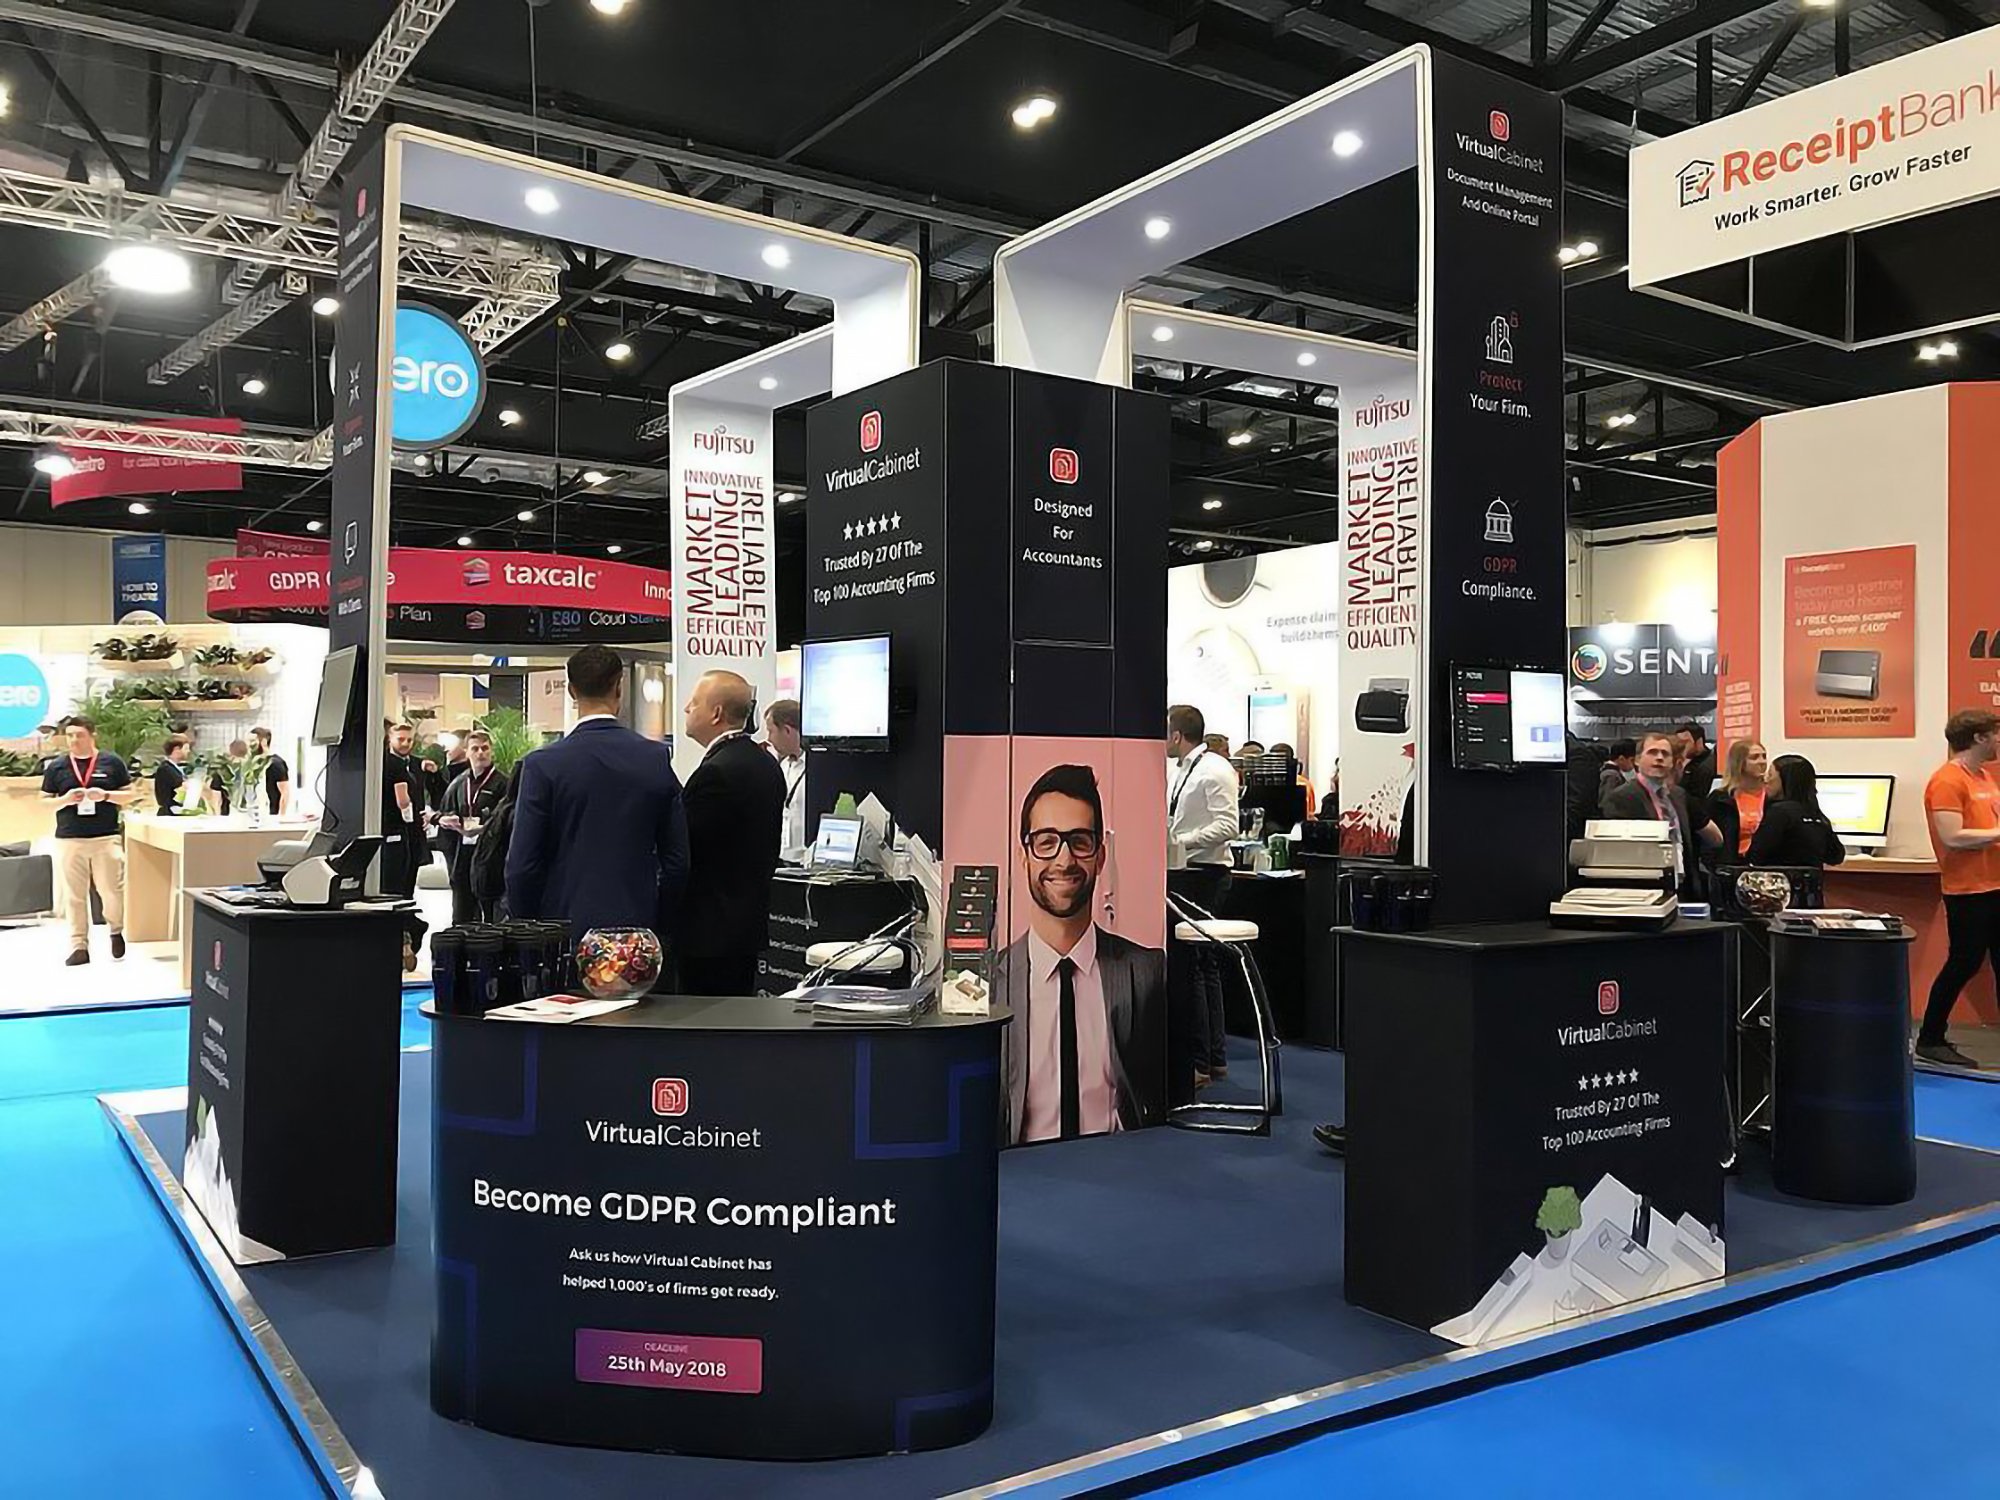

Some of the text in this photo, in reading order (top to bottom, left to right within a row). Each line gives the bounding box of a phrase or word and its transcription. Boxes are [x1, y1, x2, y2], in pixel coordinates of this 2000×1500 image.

[1456, 132, 1544, 174] VirtualCabinet
[1447, 167, 1553, 208] Document Management
[1714, 145, 1972, 231] Work Smarter. Grow Faster
[1461, 195, 1540, 227] And Online Portal
[391, 356, 469, 398] ero
[1480, 370, 1523, 392] Protect
[1355, 394, 1410, 428] FUJITSU
[1470, 392, 1532, 418] Your Firm.
[694, 425, 754, 455] FUJITSU
[1347, 438, 1418, 466] INNOVATIVE
[684, 468, 764, 490] INNOVATIVE
[825, 448, 921, 492] VirtualCabinet
[1033, 498, 1093, 519] Designed
[1053, 526, 1074, 541] For
[1348, 469, 1371, 605] MARKET
[1372, 461, 1395, 604] LEADING
[685, 486, 713, 616] MARKET
[714, 489, 741, 617] LEADING
[741, 490, 765, 618] RELIABLE
[824, 541, 923, 573] Trusted By 27 Of The
[1023, 547, 1103, 569] Accountants
[1483, 556, 1517, 573] GDPR
[269, 571, 320, 590] GDPR
[503, 561, 672, 601] taxcalc Inno
[813, 570, 936, 606] Top 100 Accounting Firms
[1461, 579, 1537, 600] Compliance.
[400, 606, 431, 621] Plan
[686, 617, 766, 637] EFFICIENT
[687, 637, 766, 658] QUALITY
[1347, 627, 1416, 650] QUALITY
[1614, 648, 1718, 675] SENT
[1557, 1018, 1658, 1047] VirtualCabinet
[1555, 1091, 1661, 1121] Trusted By 27 Of The
[585, 1119, 762, 1149] VirtualCabinet
[1542, 1115, 1671, 1152] Top 100 Accounting Firms
[473, 1178, 897, 1234] Become GDPR Compliant
[569, 1248, 773, 1271] Ask us how Virtual Cabinet has
[563, 1274, 779, 1301] helped 1,000's of firms get ready.
[644, 1342, 689, 1354] DEADLINE
[608, 1355, 727, 1377] 25th May 2018
